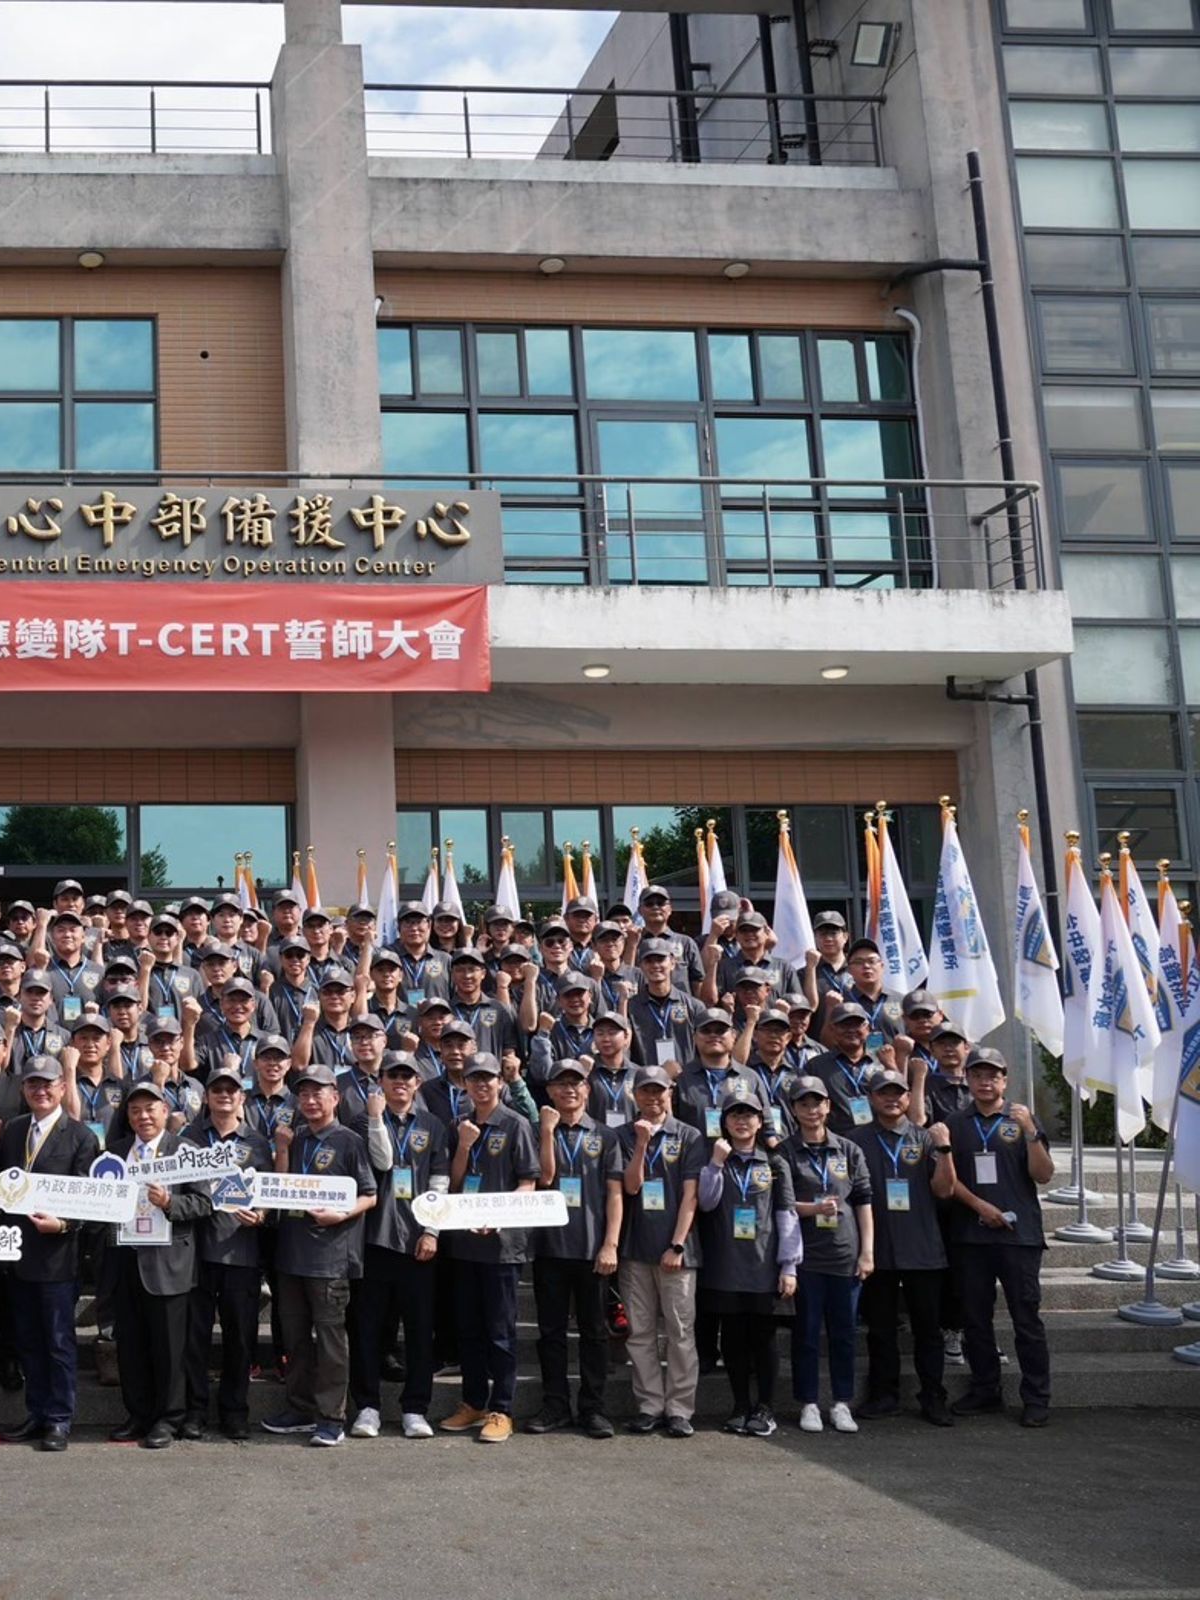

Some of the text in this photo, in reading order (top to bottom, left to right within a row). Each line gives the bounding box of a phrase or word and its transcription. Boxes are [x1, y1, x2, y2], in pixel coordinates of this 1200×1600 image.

[77, 555, 216, 578] Emergency
[224, 555, 347, 578] Operation
[355, 556, 437, 577] Center
[1066, 913, 1092, 991] 台中發電
[36, 1178, 131, 1199] 內政部消防署
[282, 1177, 322, 1189] T-CERT
